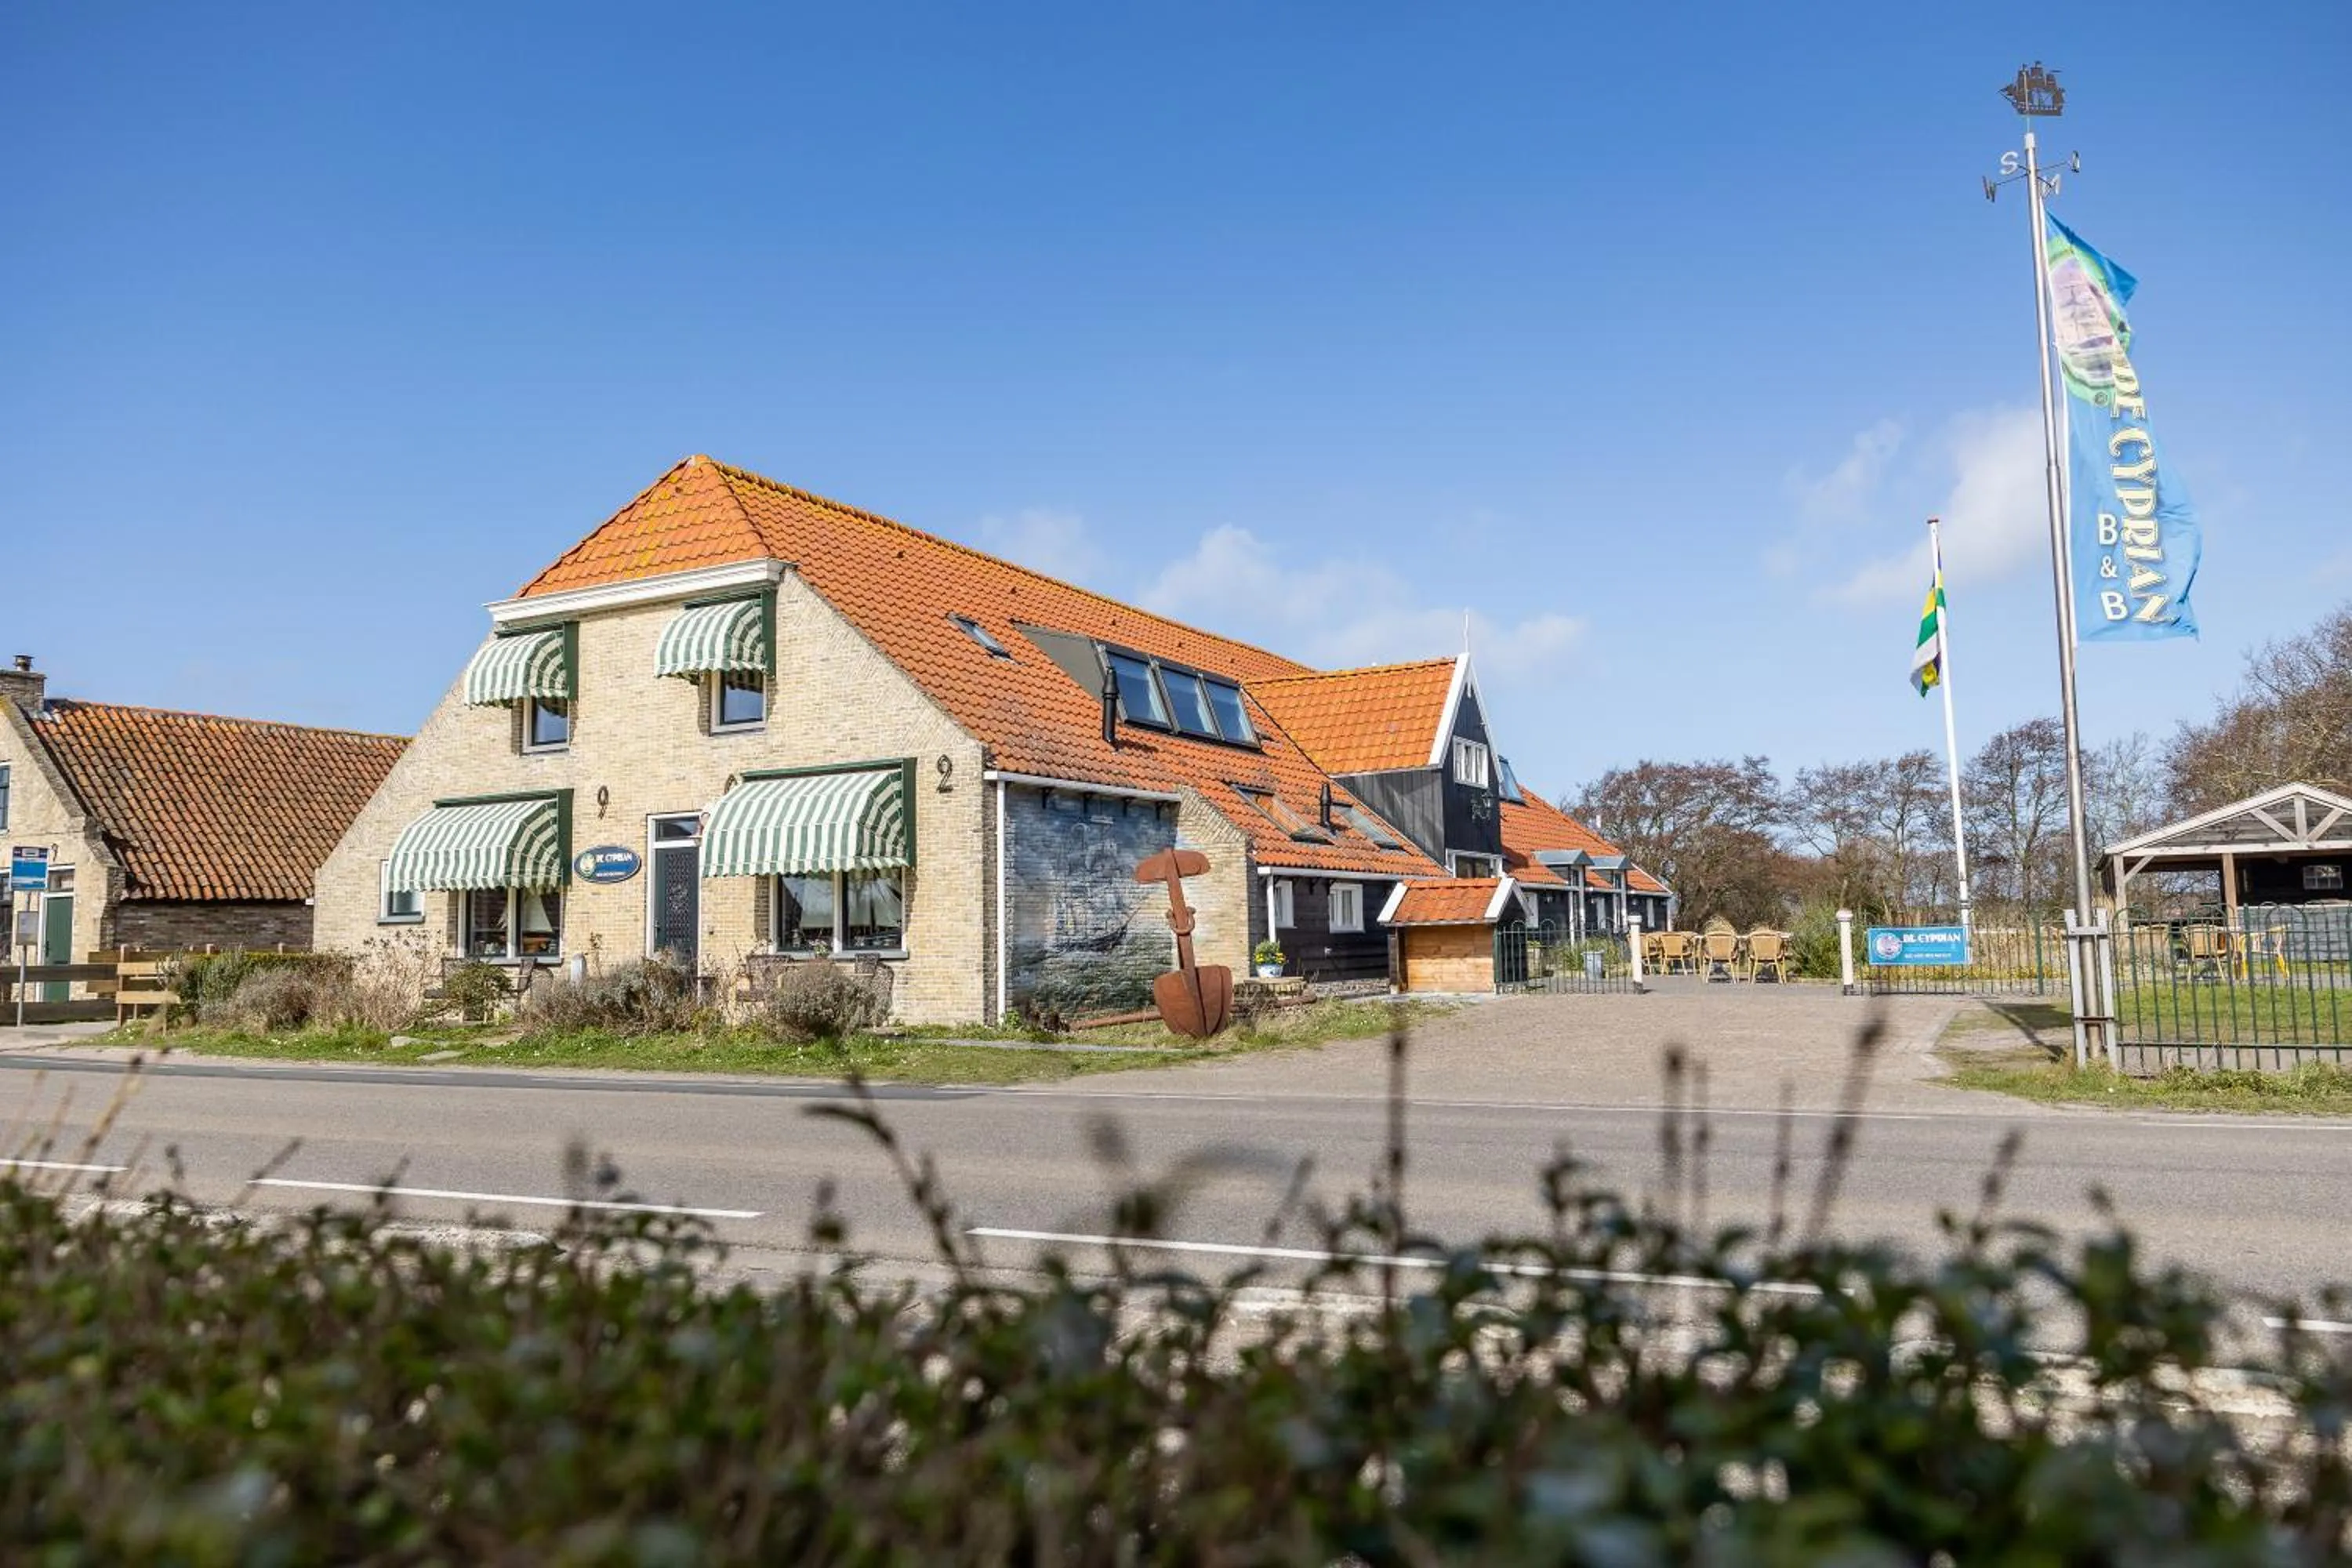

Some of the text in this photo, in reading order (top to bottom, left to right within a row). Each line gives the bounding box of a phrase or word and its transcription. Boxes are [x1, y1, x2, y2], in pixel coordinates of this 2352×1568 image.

[1999, 151, 2020, 175] S
[2097, 514, 2129, 621] B & B
[2109, 426, 2175, 624] CYPRIAN
